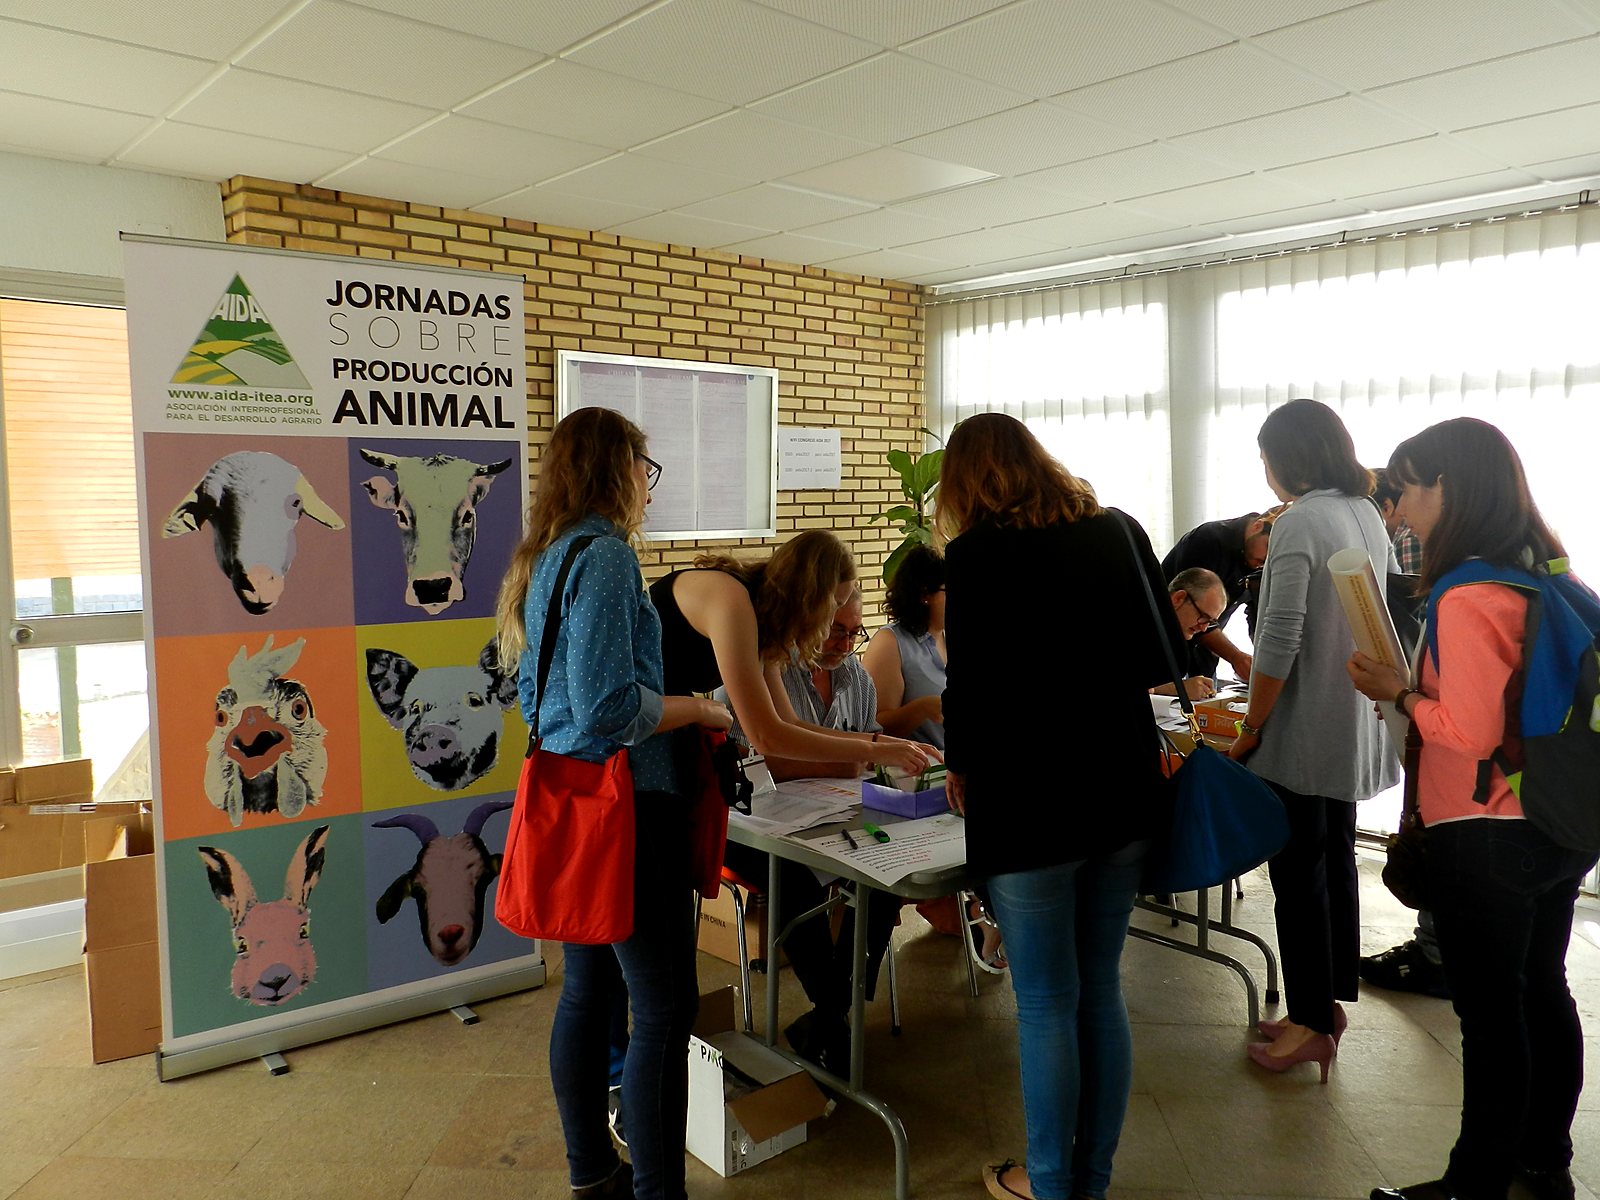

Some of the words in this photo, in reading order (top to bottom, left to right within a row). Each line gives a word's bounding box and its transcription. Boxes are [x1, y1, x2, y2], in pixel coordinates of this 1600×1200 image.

[209, 293, 271, 324] AIDA
[326, 280, 511, 320] JORNADAS
[328, 312, 512, 356] SOBRE
[333, 358, 513, 387] PRODUCCIÓN
[166, 402, 227, 412] ASOCIACIÓN
[231, 405, 321, 415] INTERPROFESIONAL
[168, 389, 313, 406] www.aida-itea.org
[332, 389, 515, 429] ANIMAL
[166, 413, 194, 421] PARA
[214, 414, 277, 424] DESARROLLO
[281, 416, 322, 425] AGRARIO
[710, 916, 726, 928] CHINA
